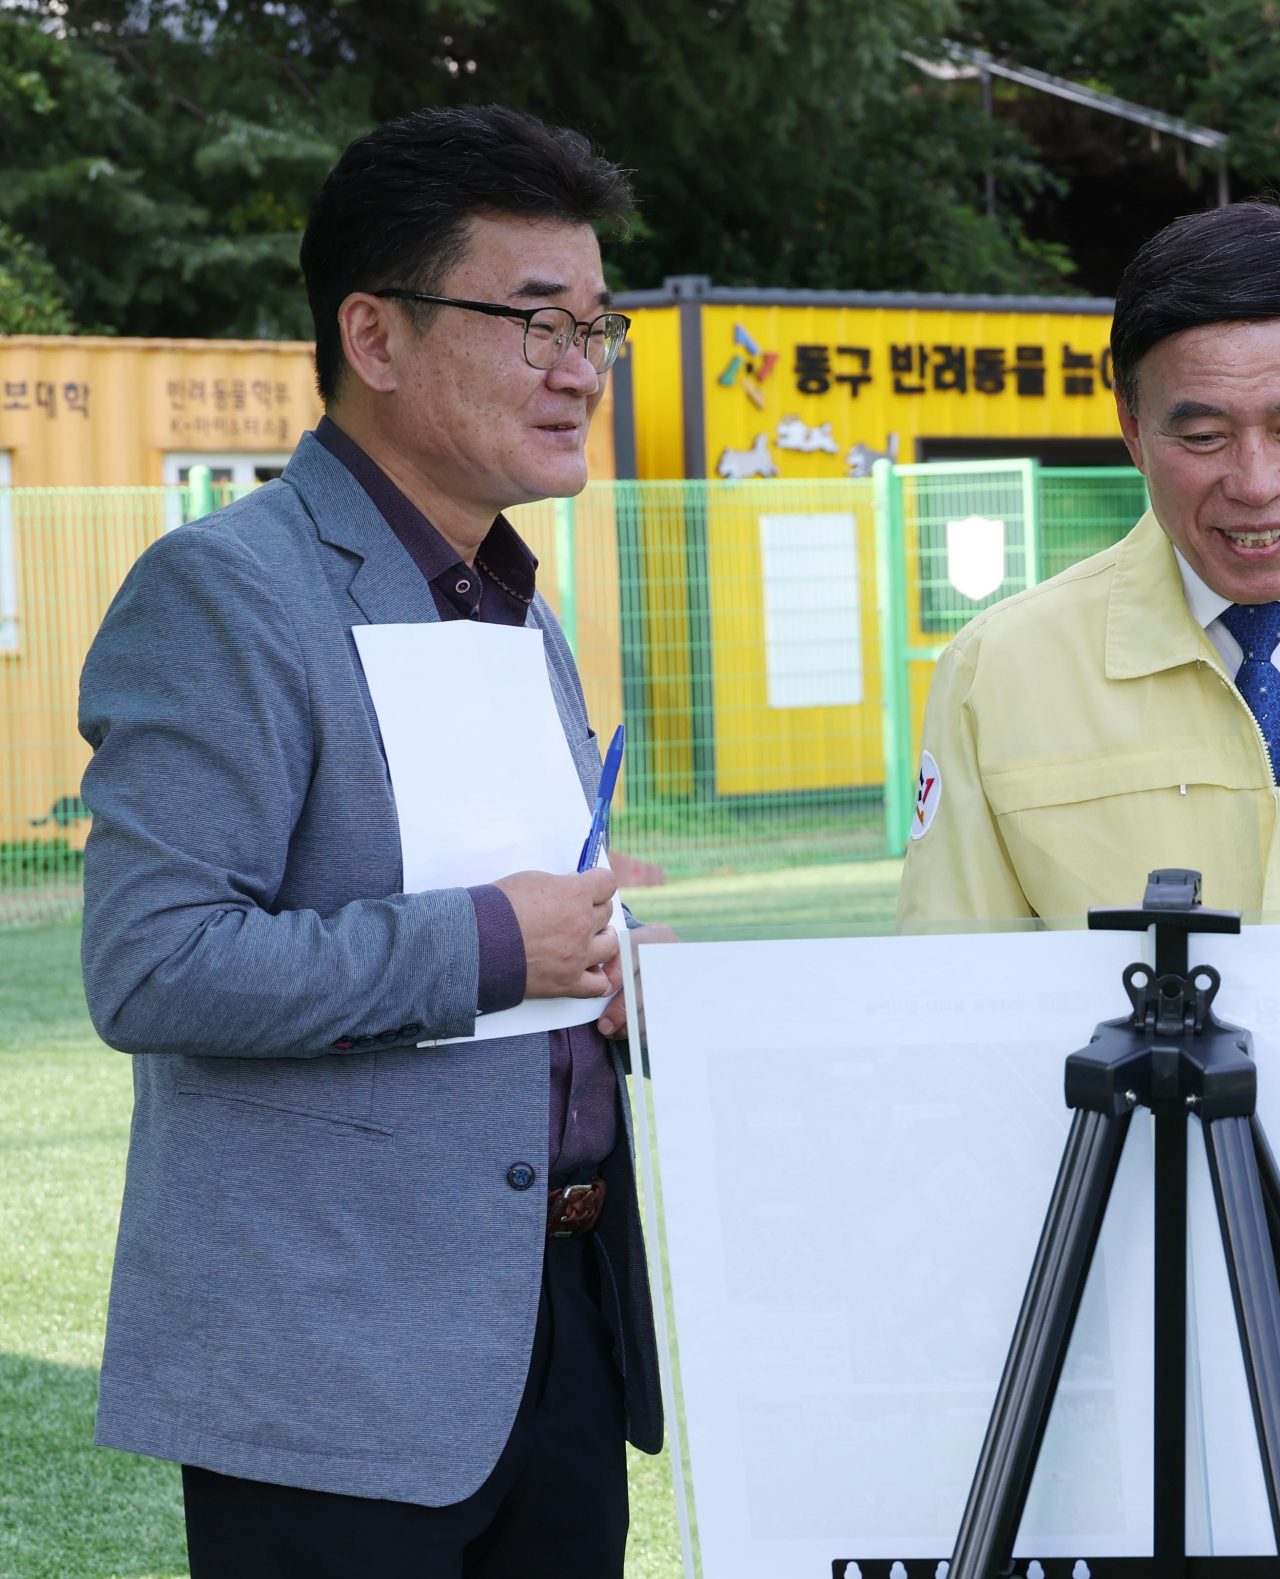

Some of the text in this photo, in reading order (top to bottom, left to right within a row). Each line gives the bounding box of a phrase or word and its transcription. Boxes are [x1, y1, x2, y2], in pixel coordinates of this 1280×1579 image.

[793, 343, 872, 397] 동구
[890, 343, 1046, 398] 반려동물
[3, 380, 90, 419] 보대학
